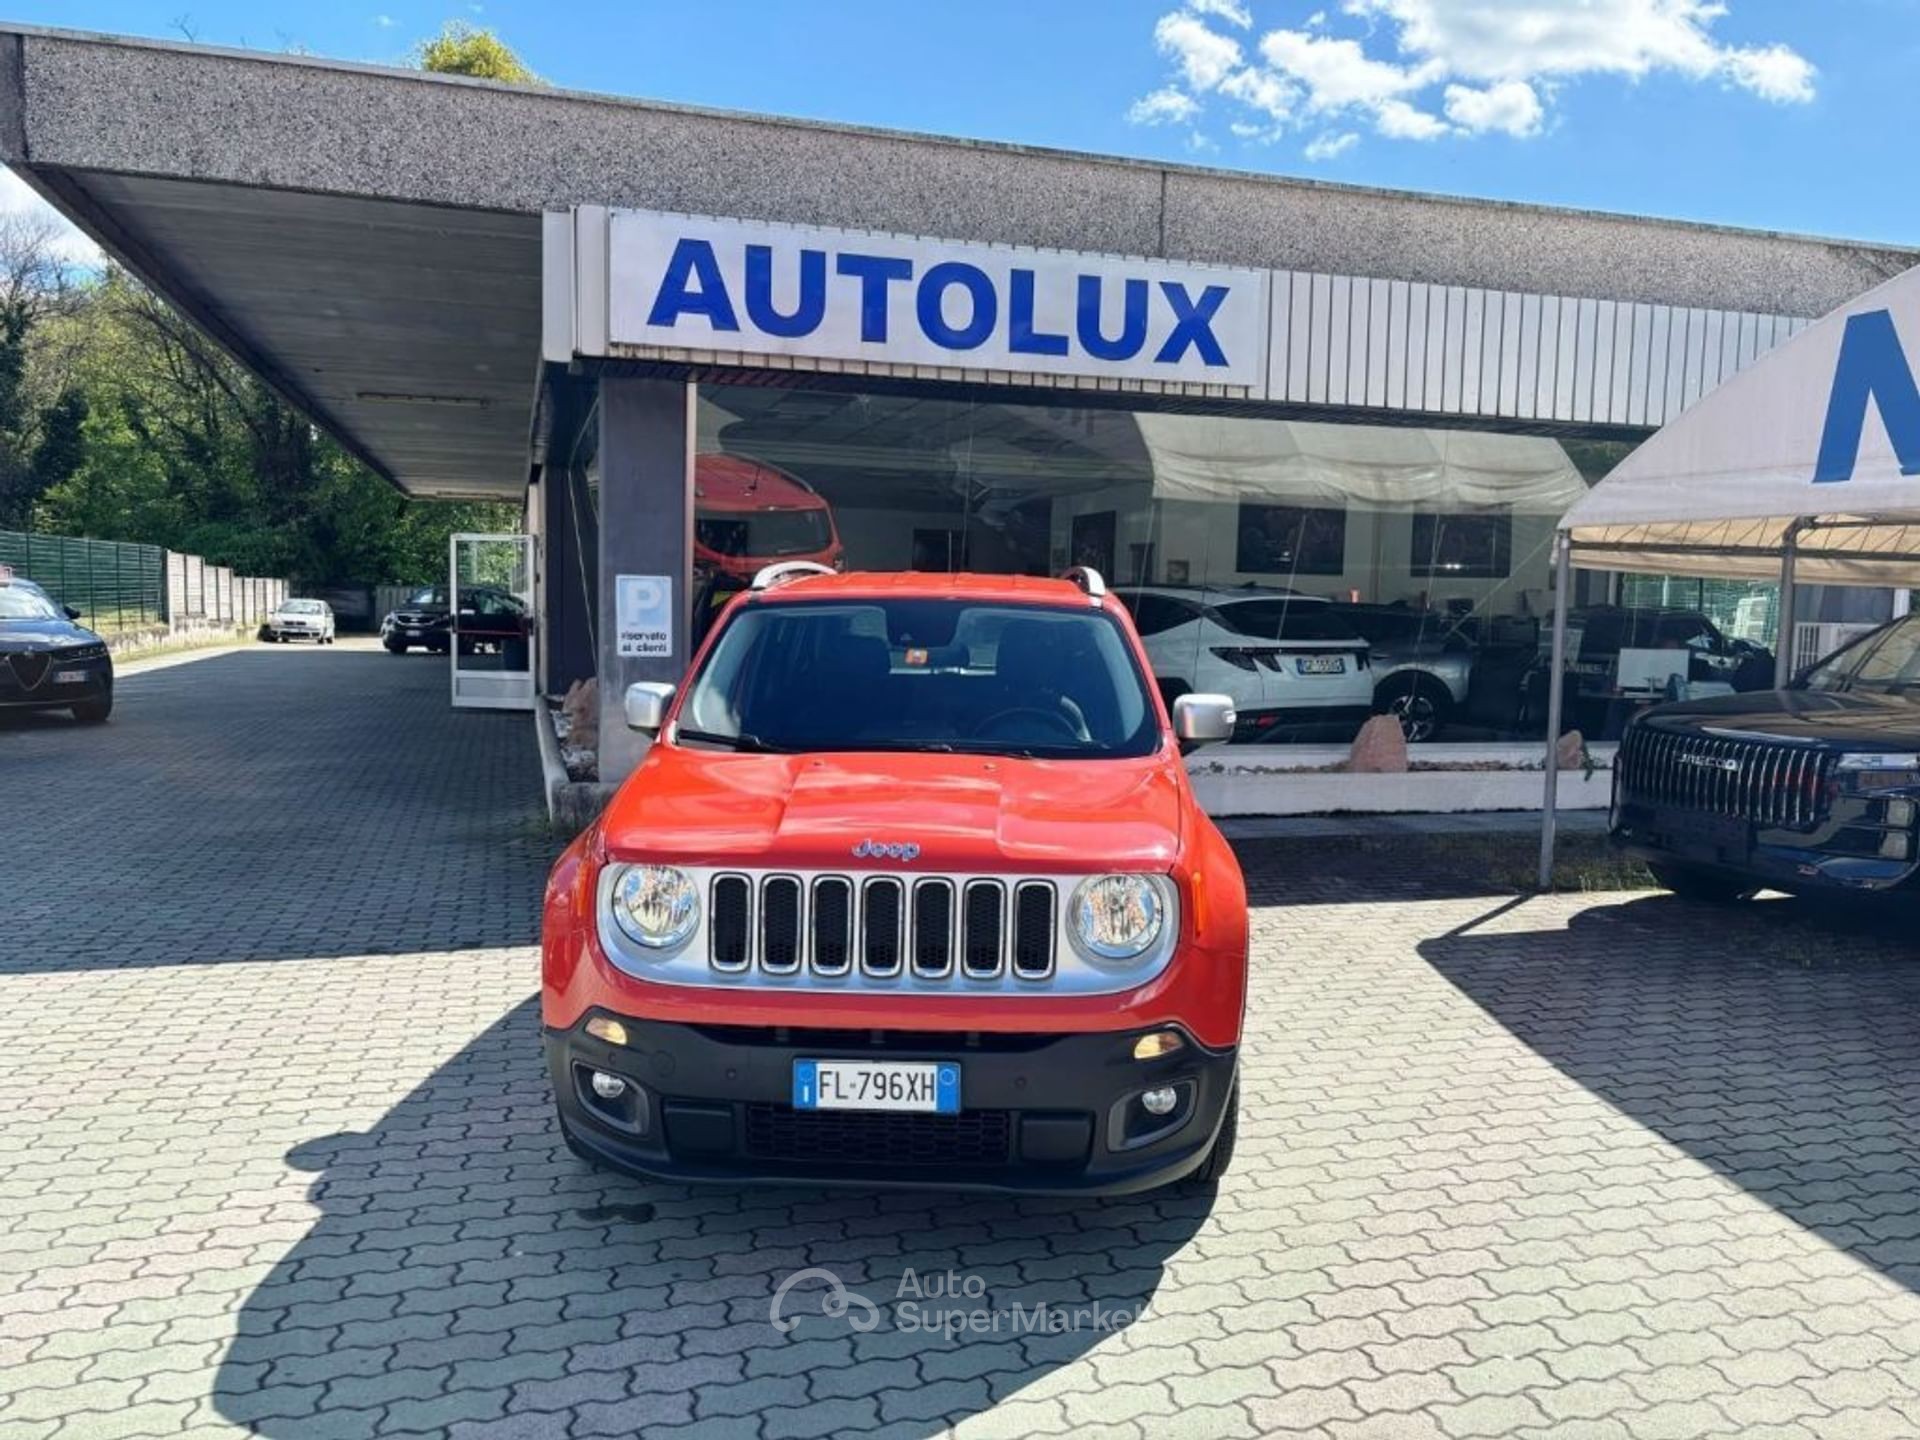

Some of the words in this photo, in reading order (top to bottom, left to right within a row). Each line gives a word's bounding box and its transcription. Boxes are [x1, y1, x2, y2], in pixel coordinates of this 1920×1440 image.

[646, 238, 1231, 367] AUTOLUX
[628, 581, 662, 622] P
[621, 631, 667, 640] riservato
[636, 642, 666, 652] clienti
[852, 839, 920, 861] Jeep
